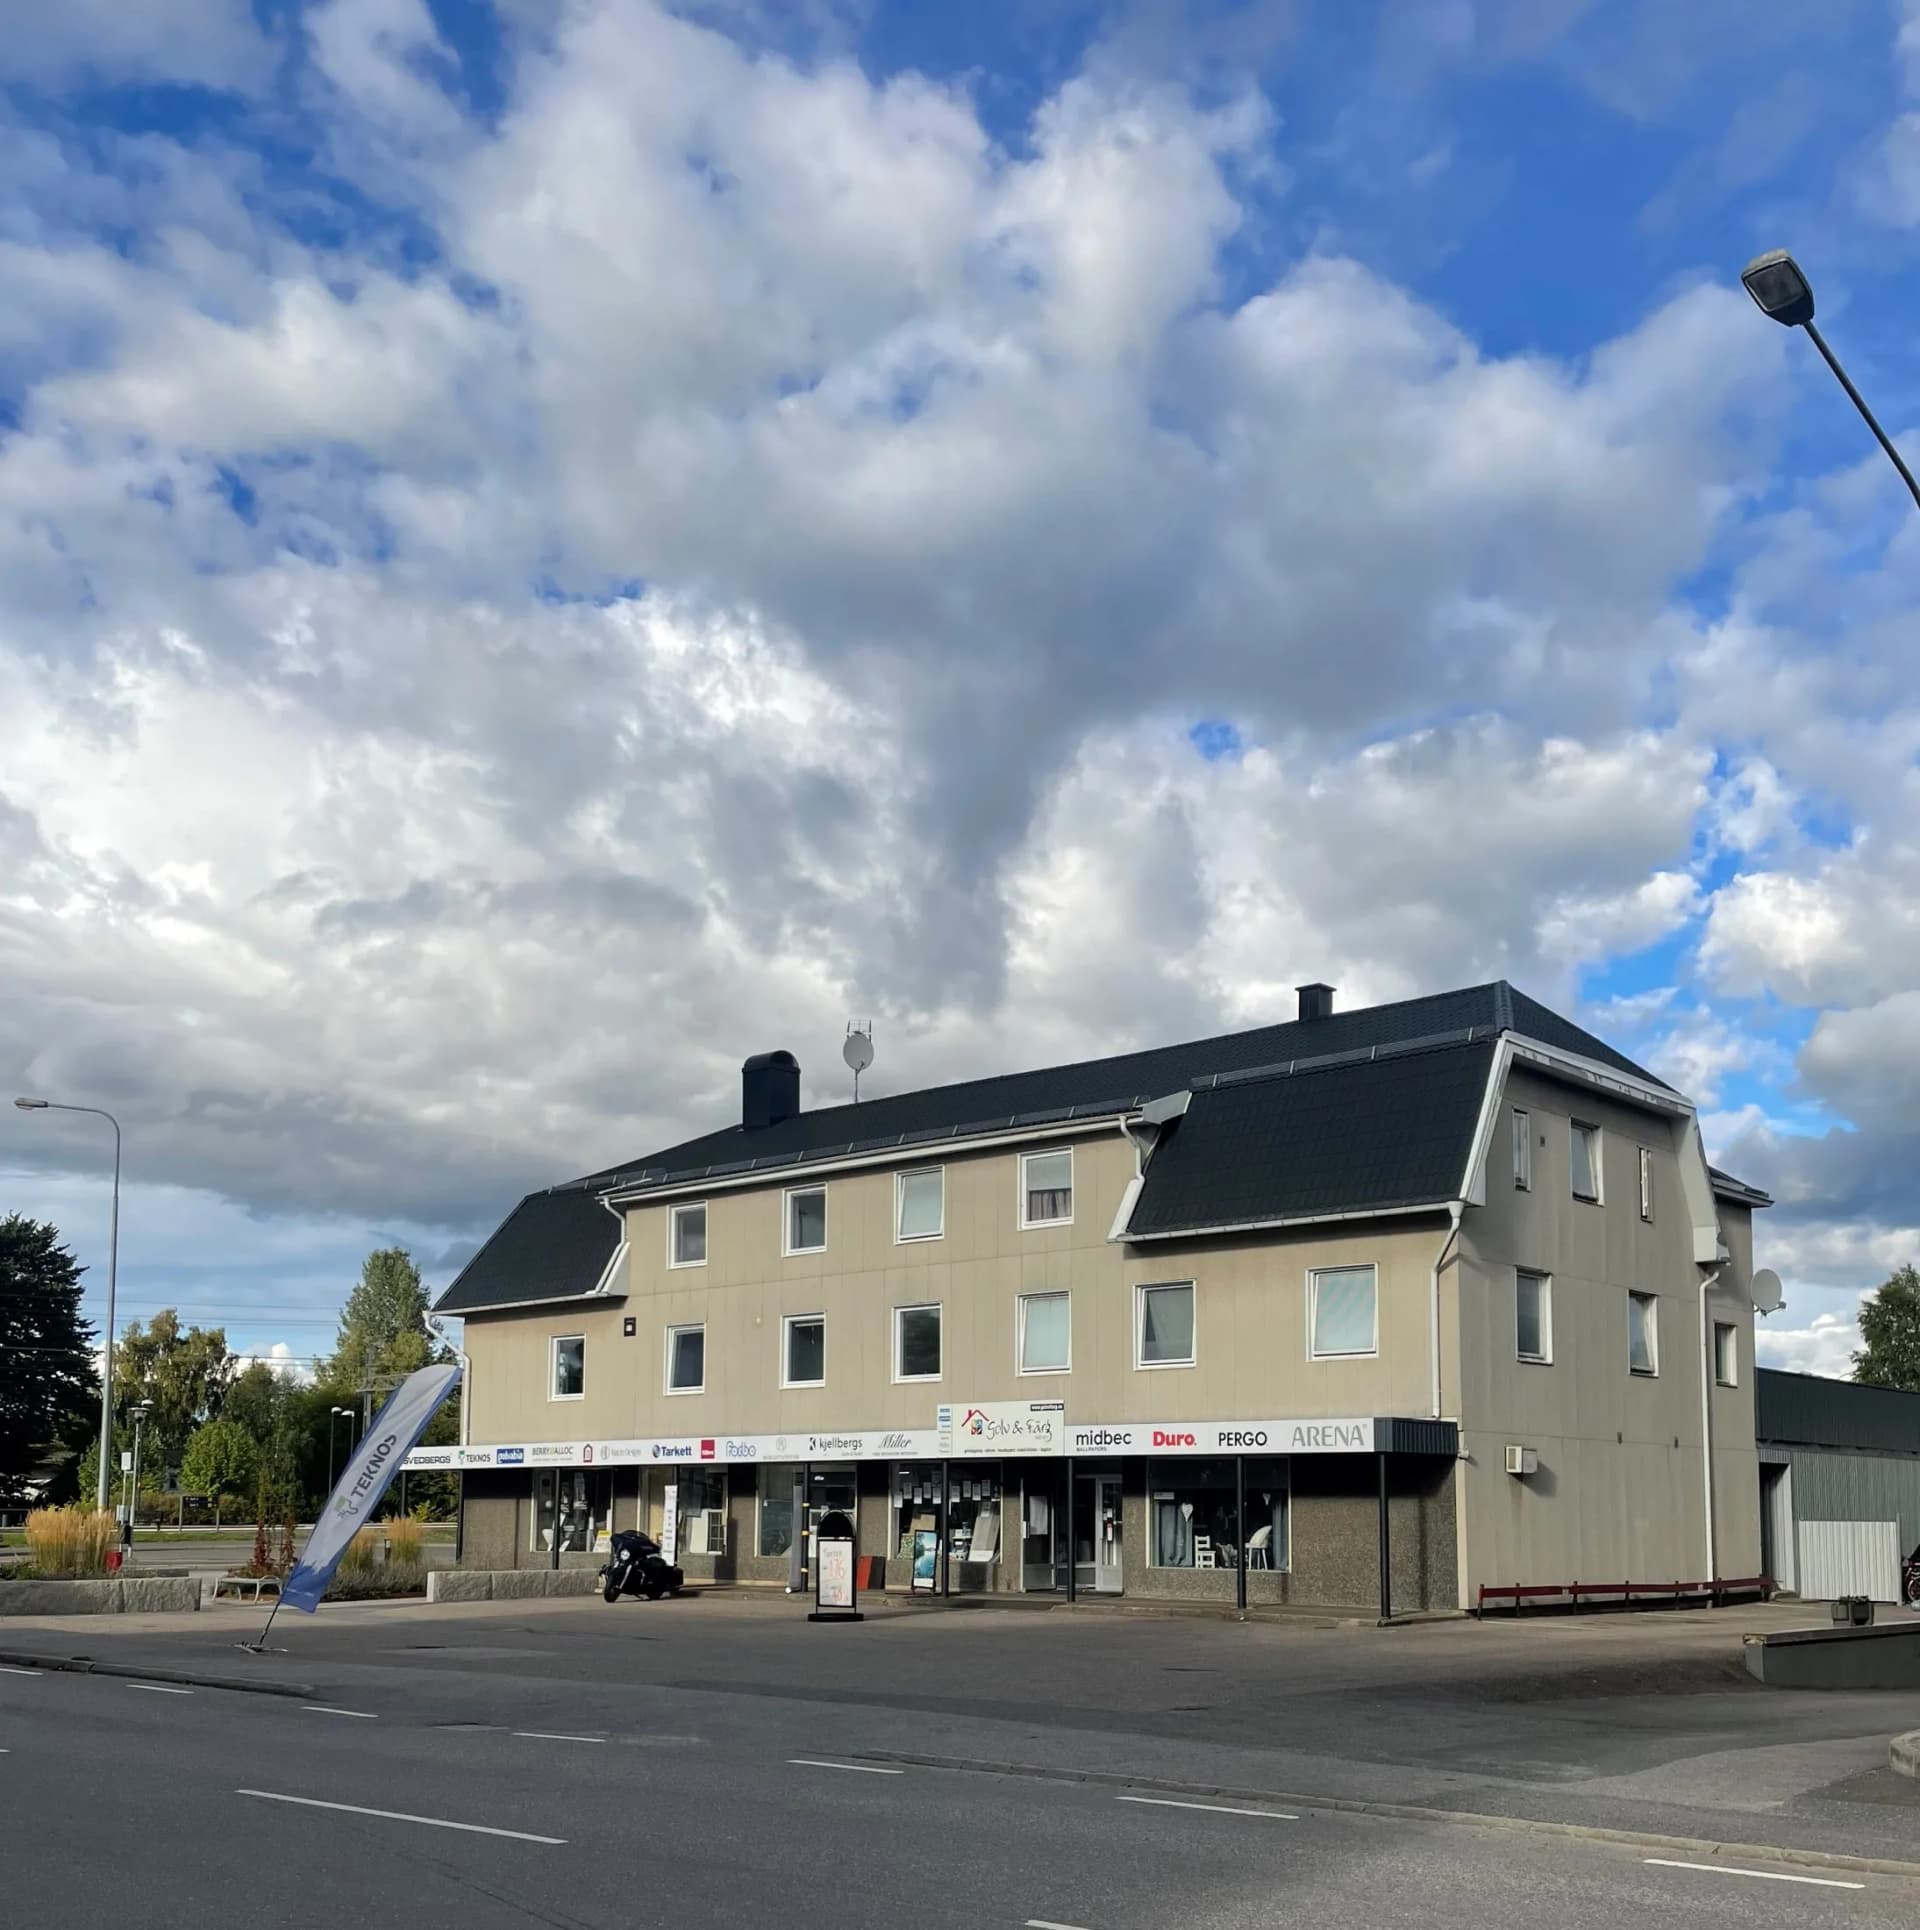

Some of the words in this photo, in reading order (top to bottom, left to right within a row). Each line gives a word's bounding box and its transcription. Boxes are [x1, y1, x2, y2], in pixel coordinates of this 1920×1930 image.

[1012, 1420, 1024, 1434] &
[878, 1433, 912, 1449] Miller
[1076, 1429, 1132, 1445] midbec
[1218, 1431, 1268, 1446] PERGO
[1292, 1424, 1365, 1447] ARENA
[661, 1445, 692, 1457] Tarkett
[819, 1437, 863, 1451] kjellbergs
[403, 1455, 451, 1465] SVEDBERGS
[466, 1453, 491, 1463] TEKNOS
[350, 1434, 397, 1497] TEKNOS
